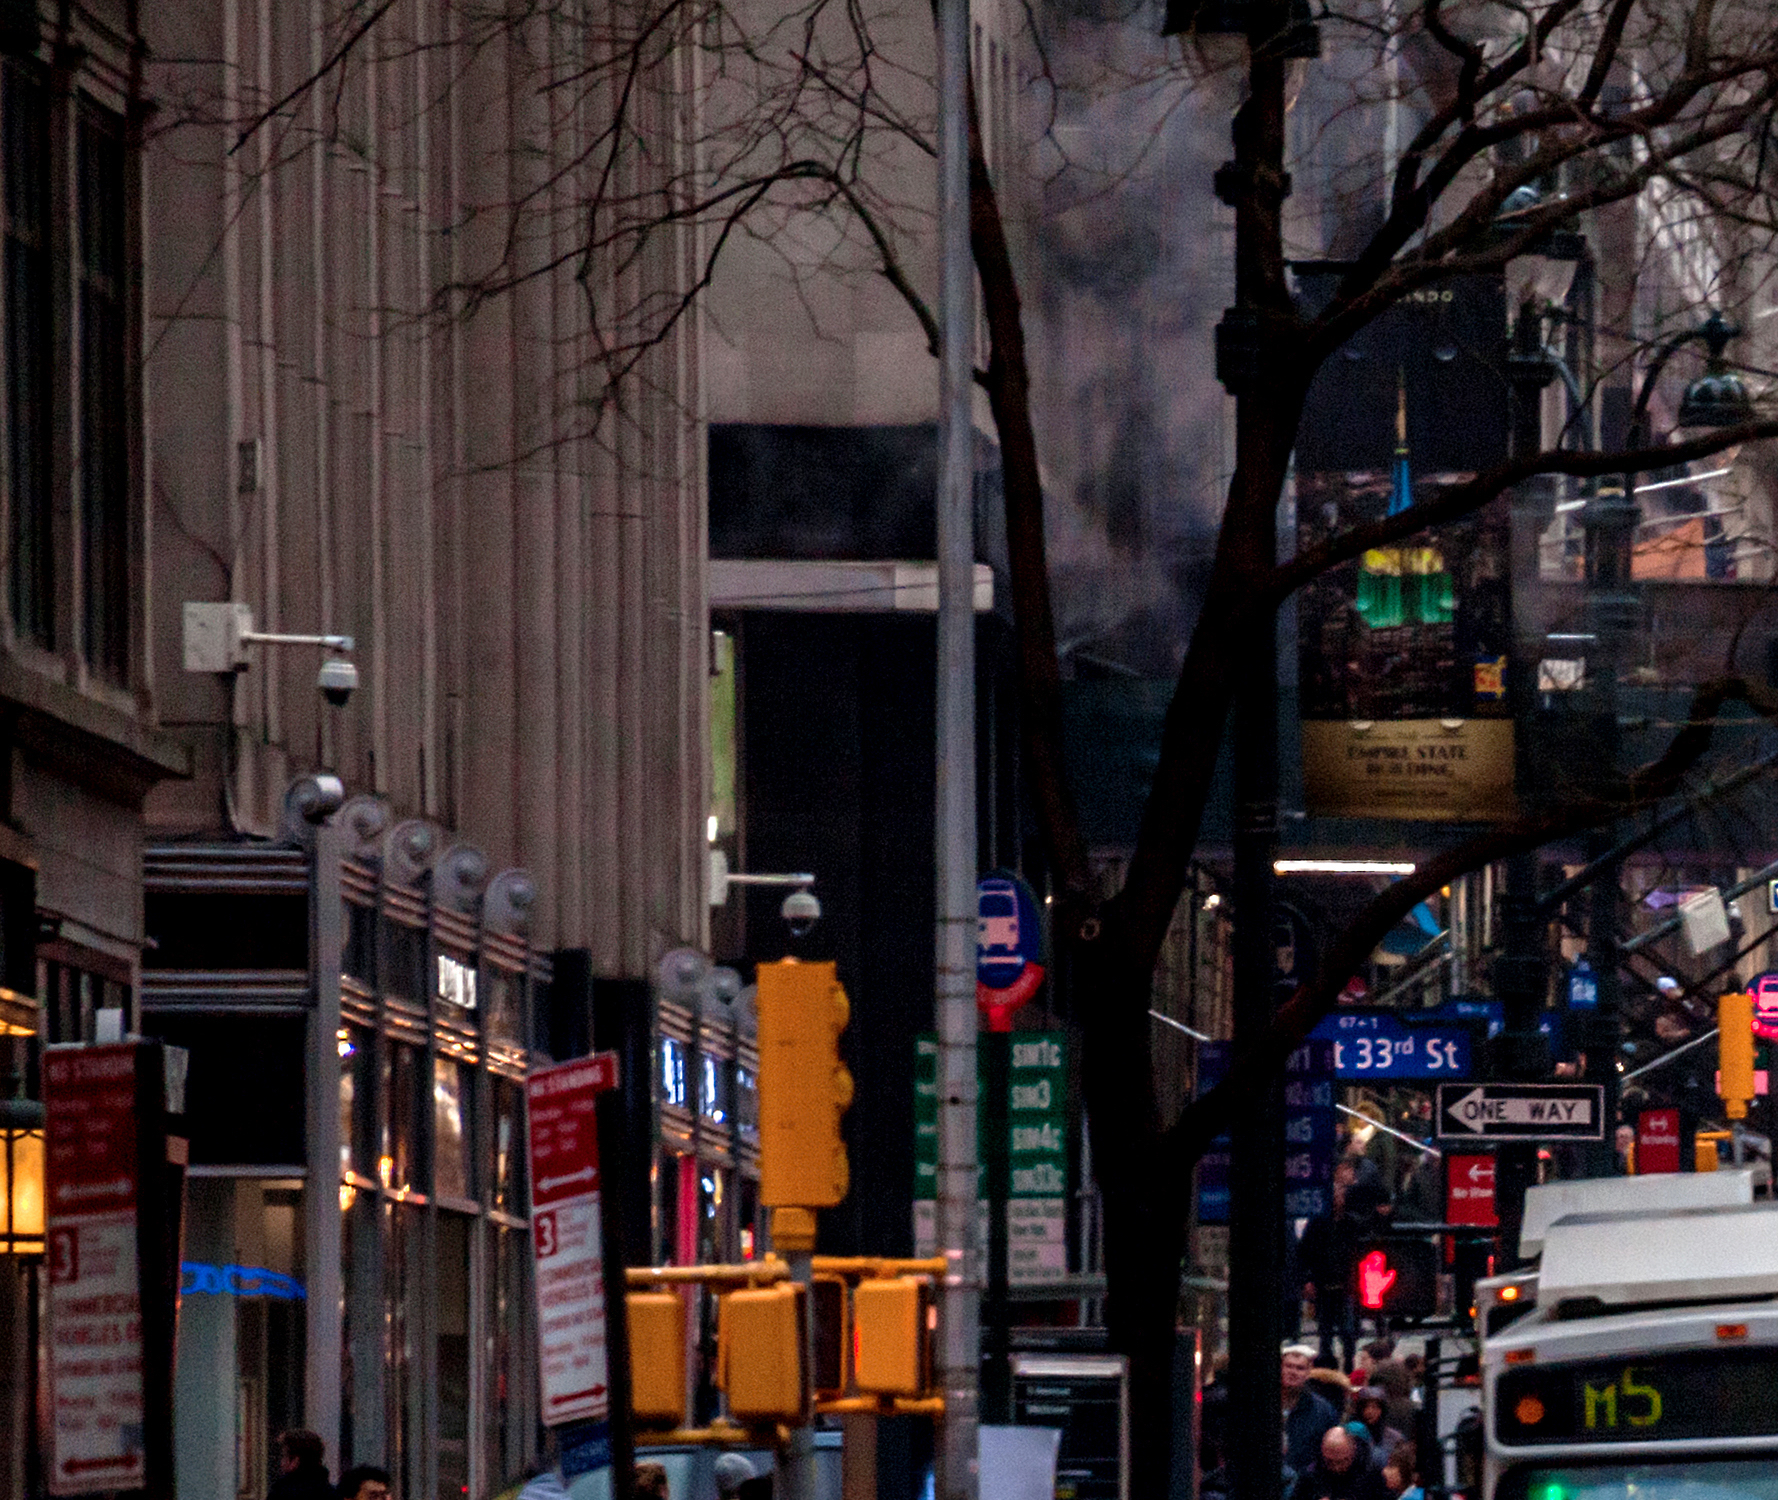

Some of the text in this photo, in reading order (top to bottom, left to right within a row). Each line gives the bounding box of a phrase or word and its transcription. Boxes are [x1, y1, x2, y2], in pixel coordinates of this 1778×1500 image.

[1417, 746, 1467, 760] STATE
[1356, 1035, 1414, 1070] 33rd
[1426, 1038, 1460, 1070] St
[1464, 1100, 1577, 1121] ONE WAY
[539, 1217, 553, 1256] 3
[1584, 1366, 1662, 1429] M5
